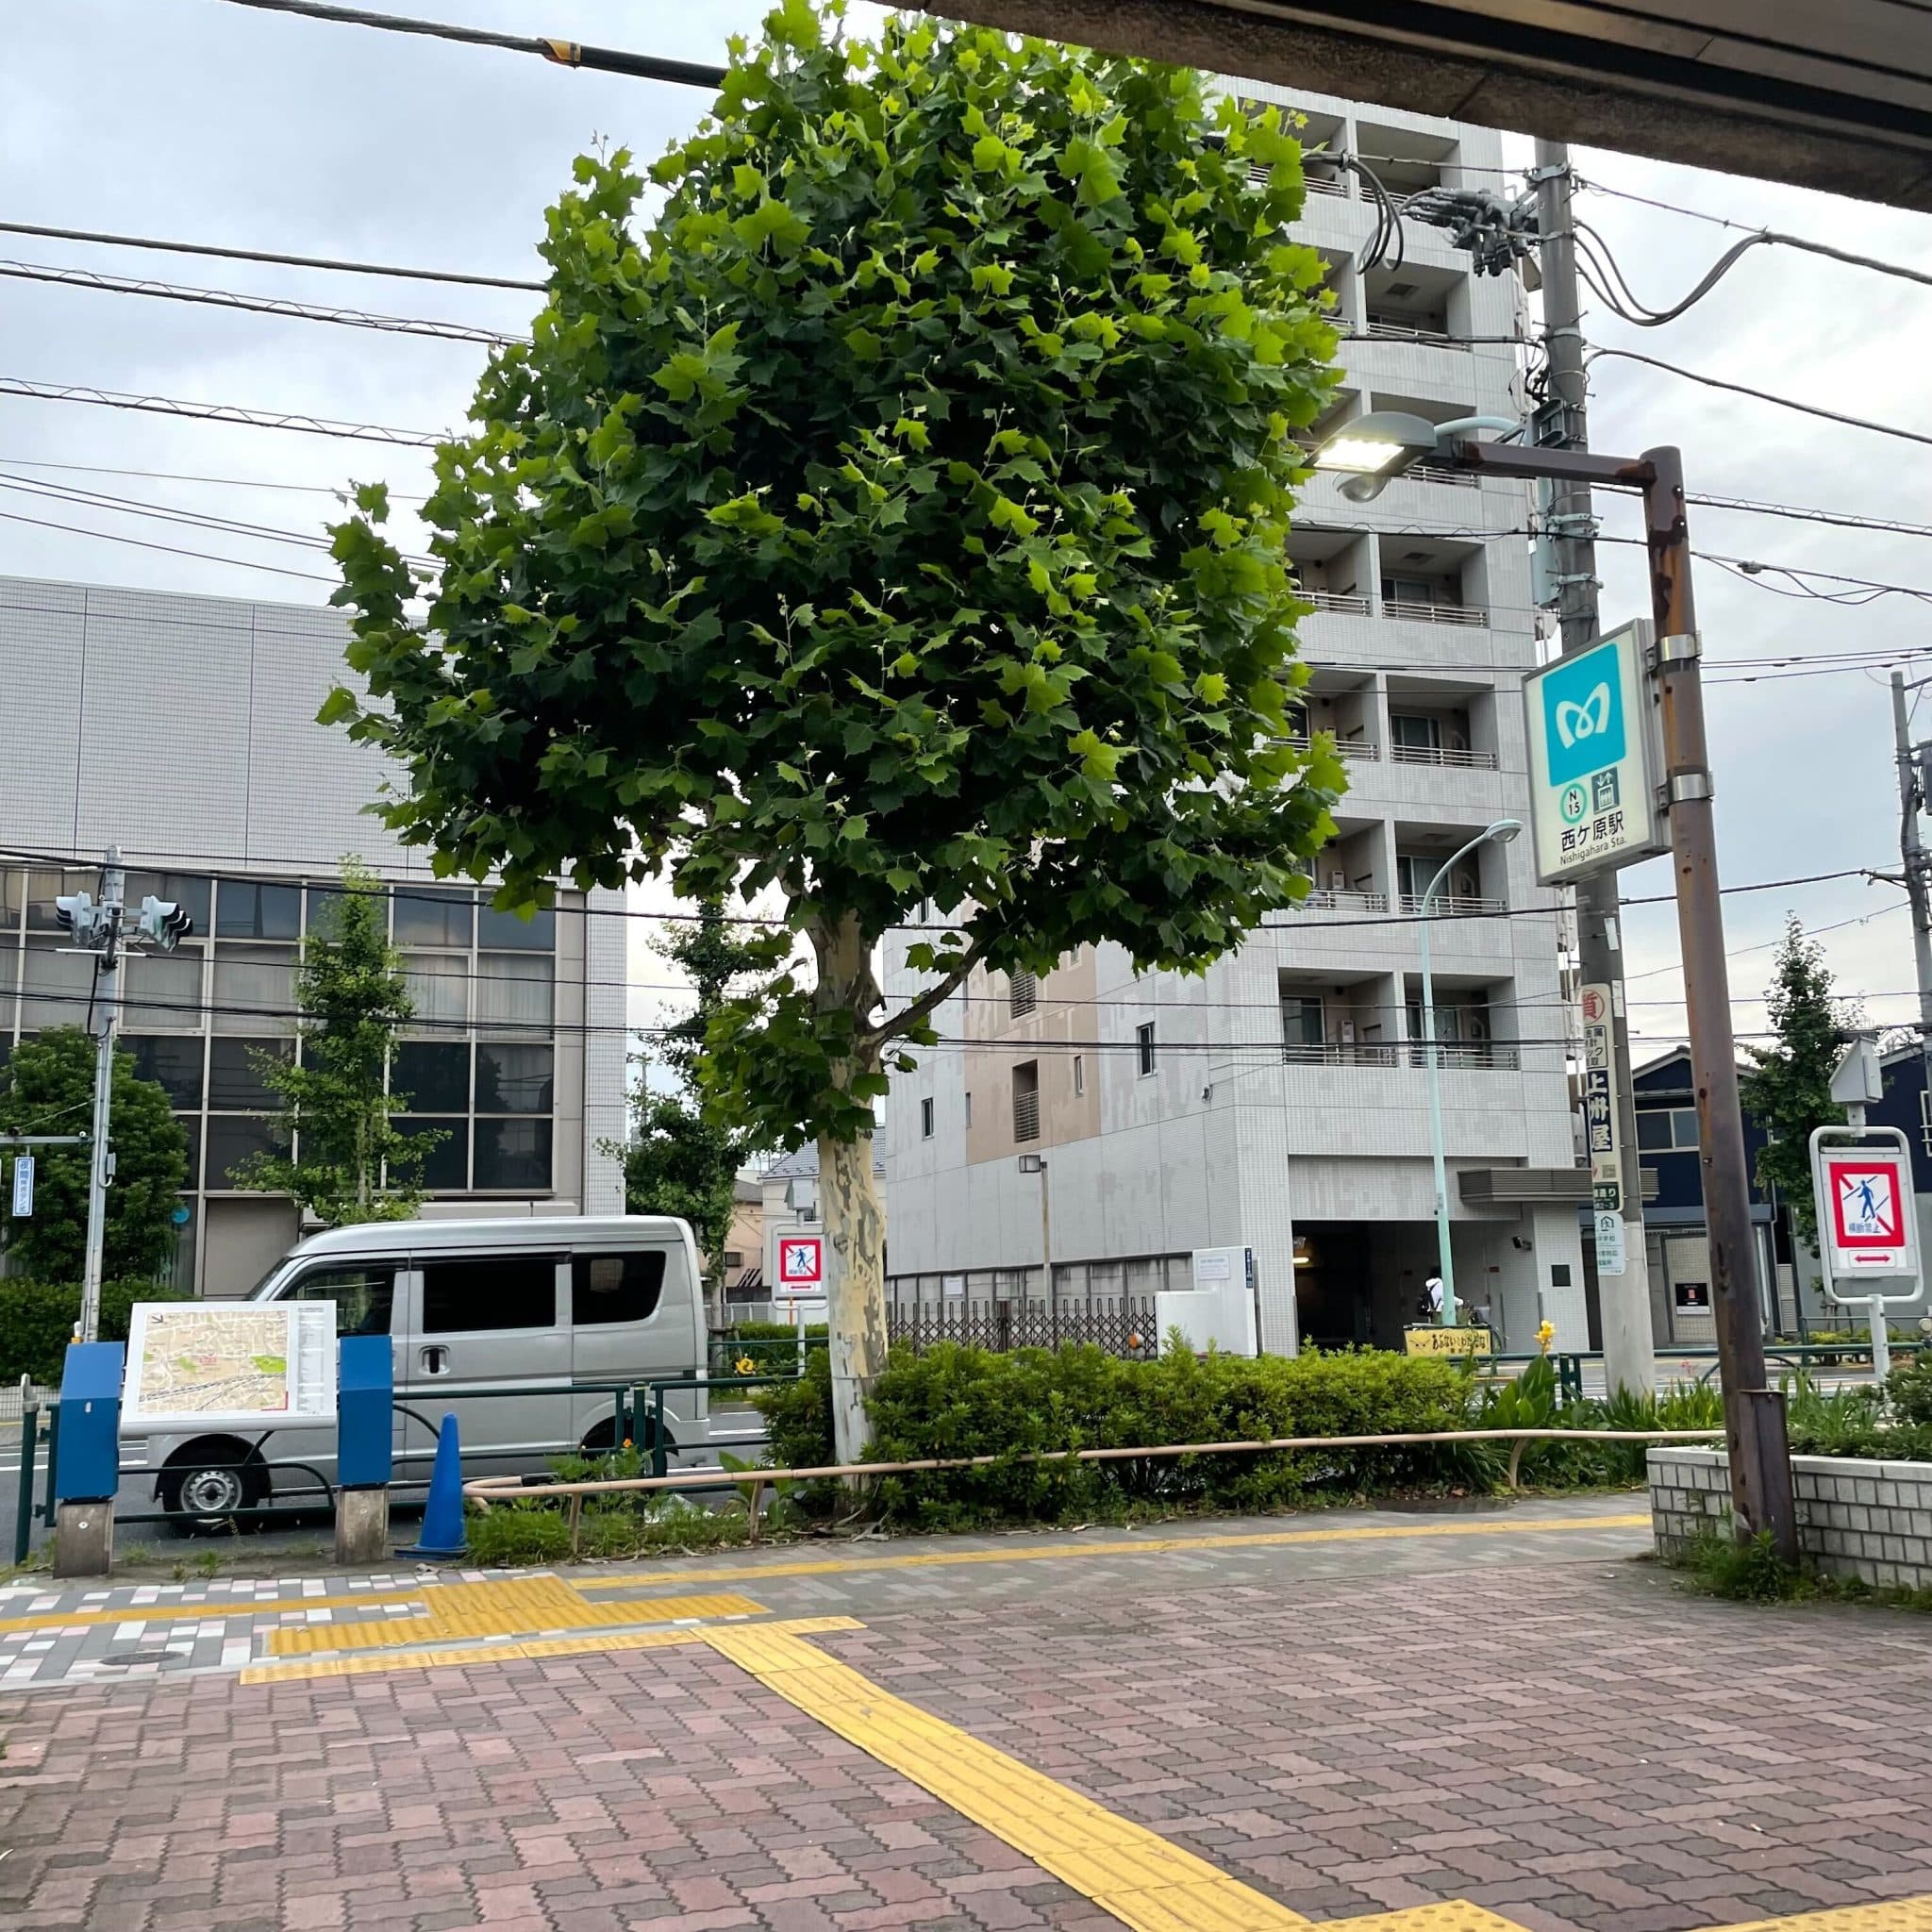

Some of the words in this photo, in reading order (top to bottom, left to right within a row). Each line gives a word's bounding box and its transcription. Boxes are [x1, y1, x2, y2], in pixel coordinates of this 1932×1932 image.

[1569, 790, 1577, 802] N
[1568, 802, 1580, 816] 15
[1559, 841, 1608, 865] Nishigahara
[1610, 836, 1626, 848] Sta.
[1588, 1073, 1611, 1150] 上州屋
[1848, 1223, 1882, 1234] 横断禁止
